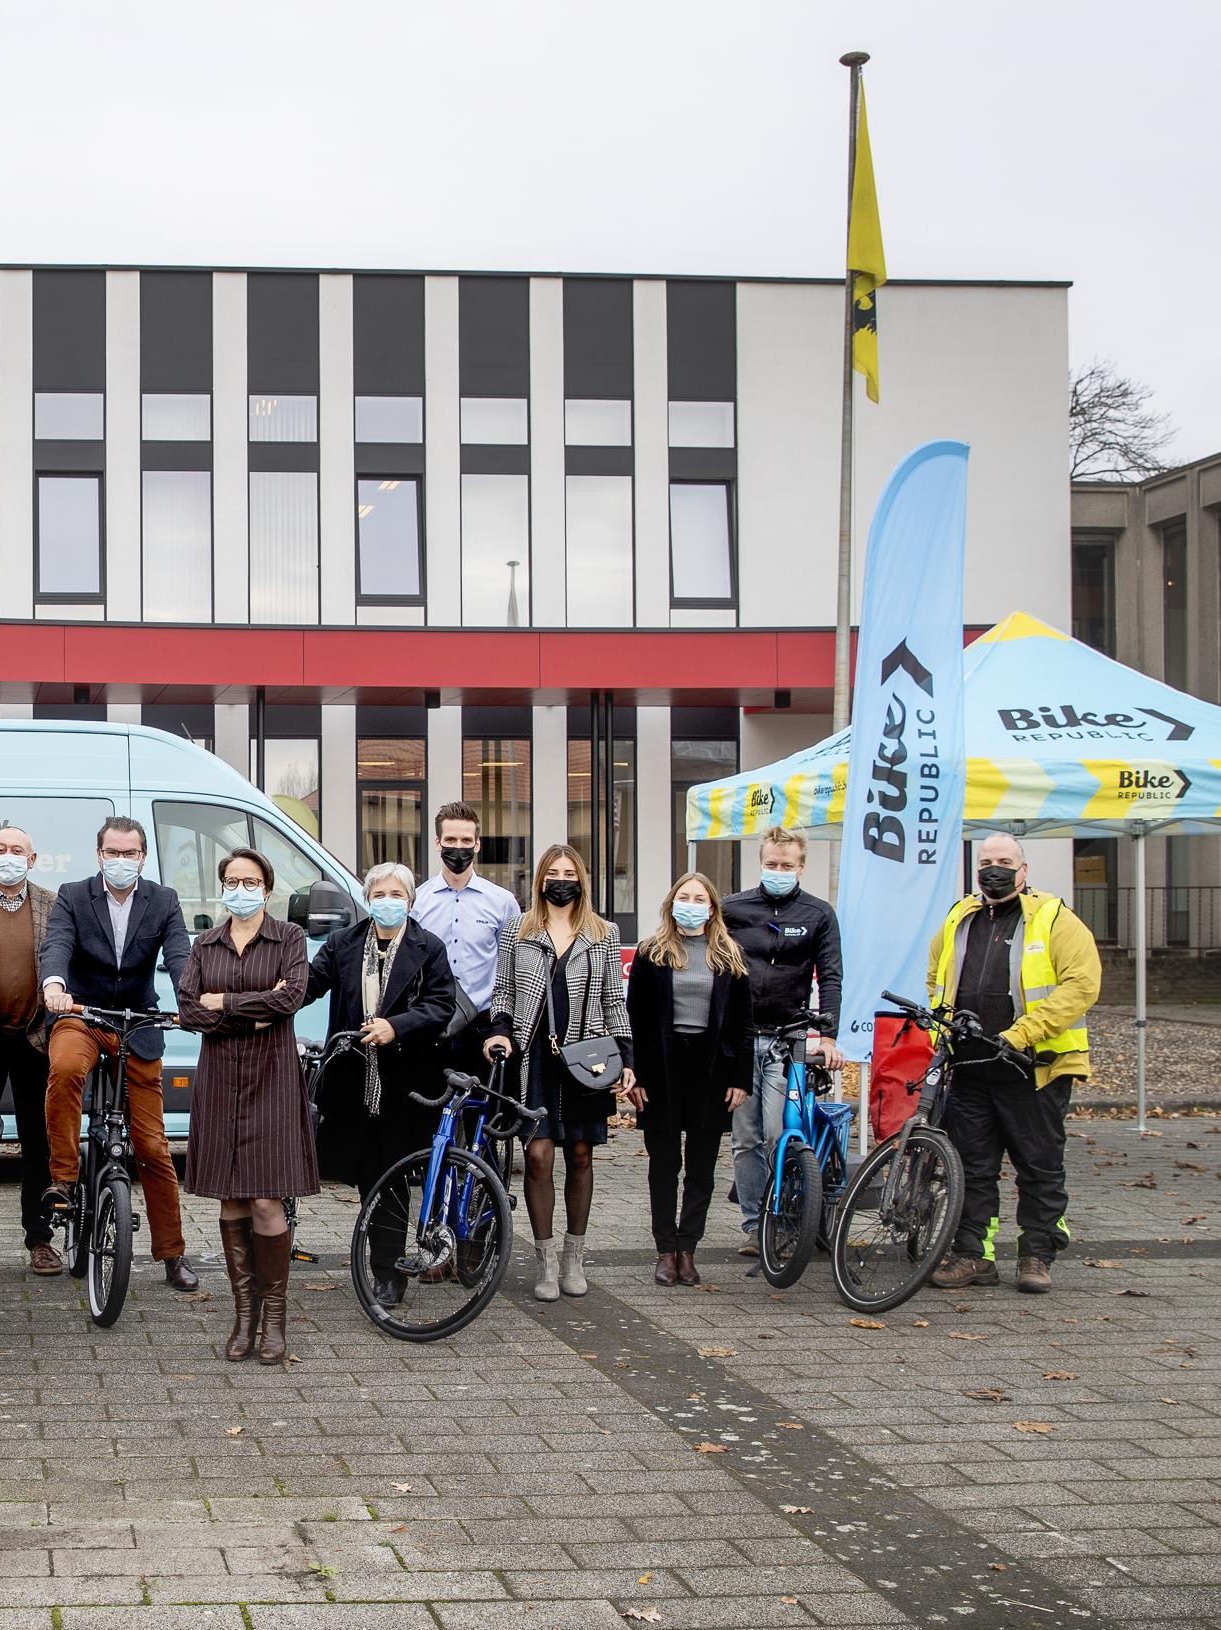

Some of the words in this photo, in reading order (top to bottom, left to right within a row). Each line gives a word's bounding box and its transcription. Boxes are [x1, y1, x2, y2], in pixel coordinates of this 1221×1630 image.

[997, 705, 1147, 731] Bike
[1011, 730, 1154, 742] REPUBLIC
[862, 692, 908, 863] Bike
[915, 708, 940, 865] REPUBLIC
[1118, 769, 1174, 789] Bike
[751, 789, 769, 807] Bike
[1117, 791, 1172, 800] REPUBLIC
